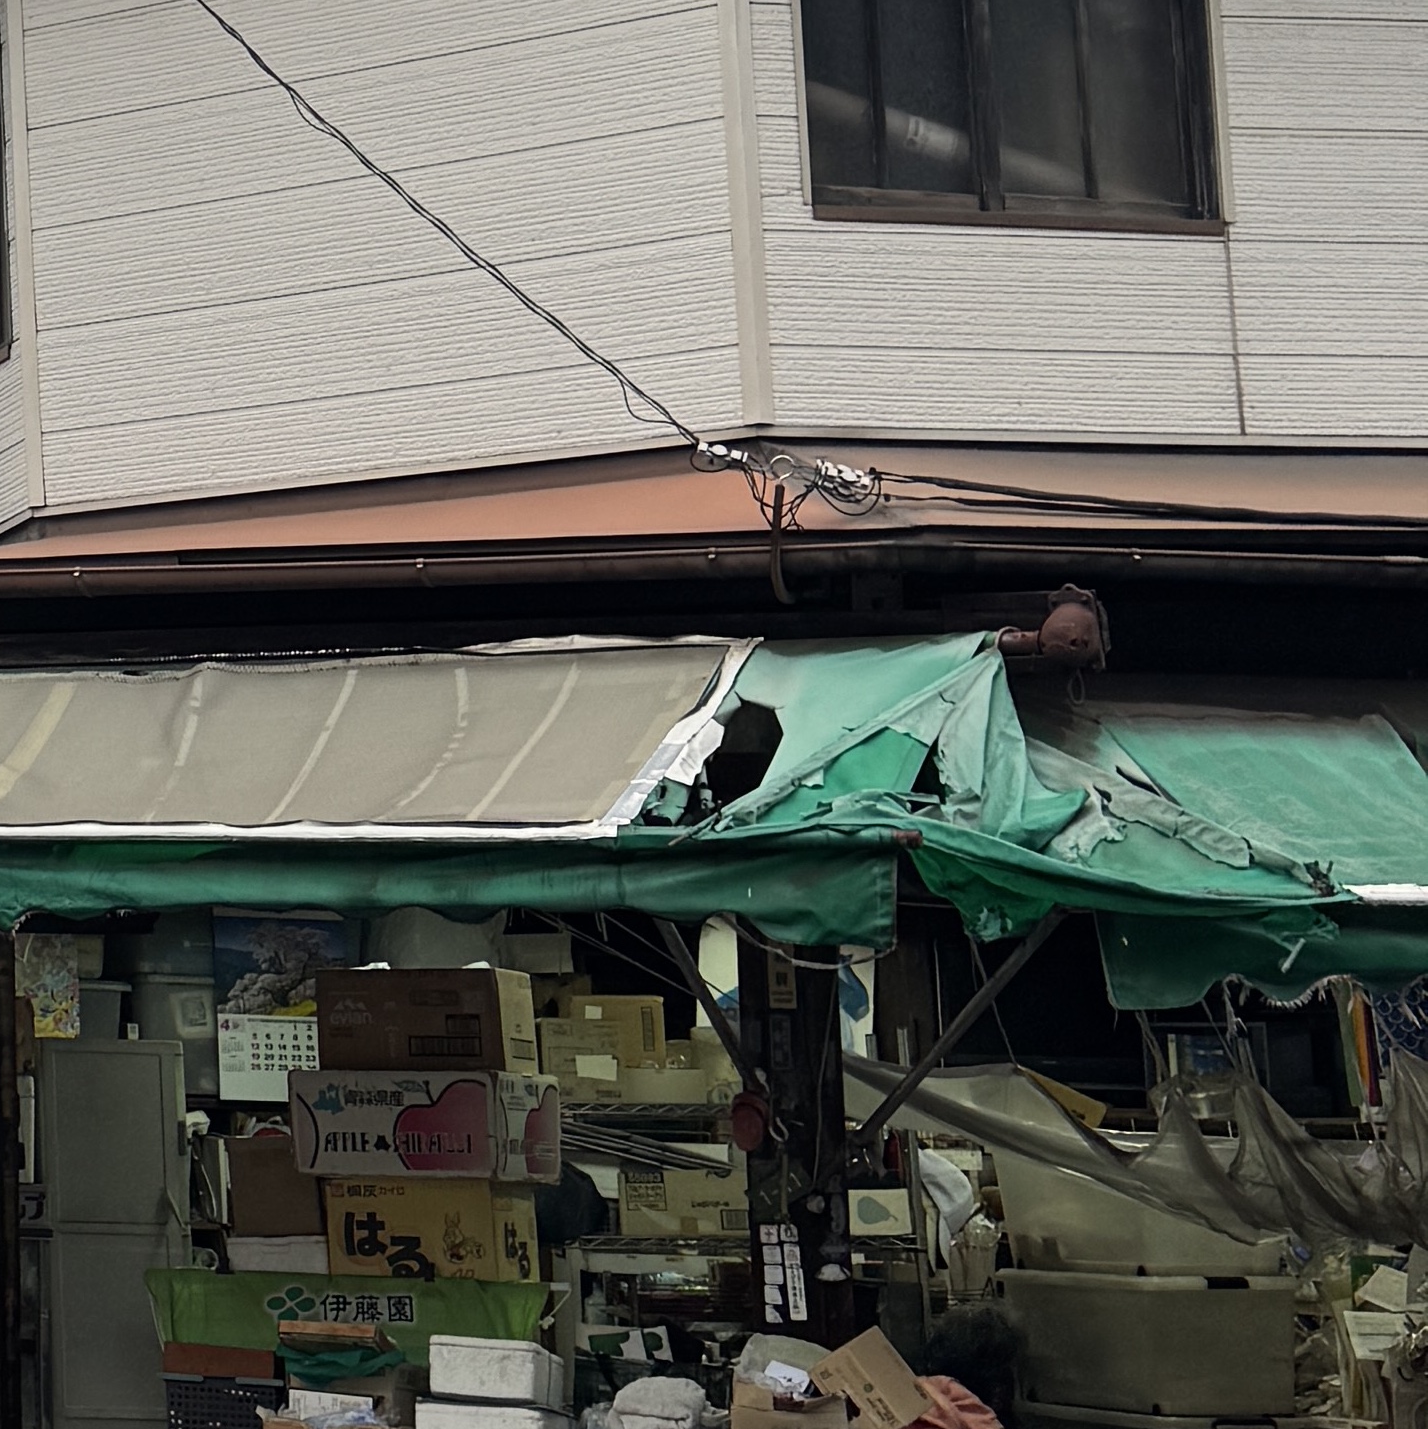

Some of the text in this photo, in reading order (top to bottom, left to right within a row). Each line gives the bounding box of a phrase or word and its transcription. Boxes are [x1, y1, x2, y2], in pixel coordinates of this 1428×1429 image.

[325, 1132, 369, 1152] APPLE
[344, 1212, 435, 1282] はる
[320, 1294, 413, 1322] 伊藤園
